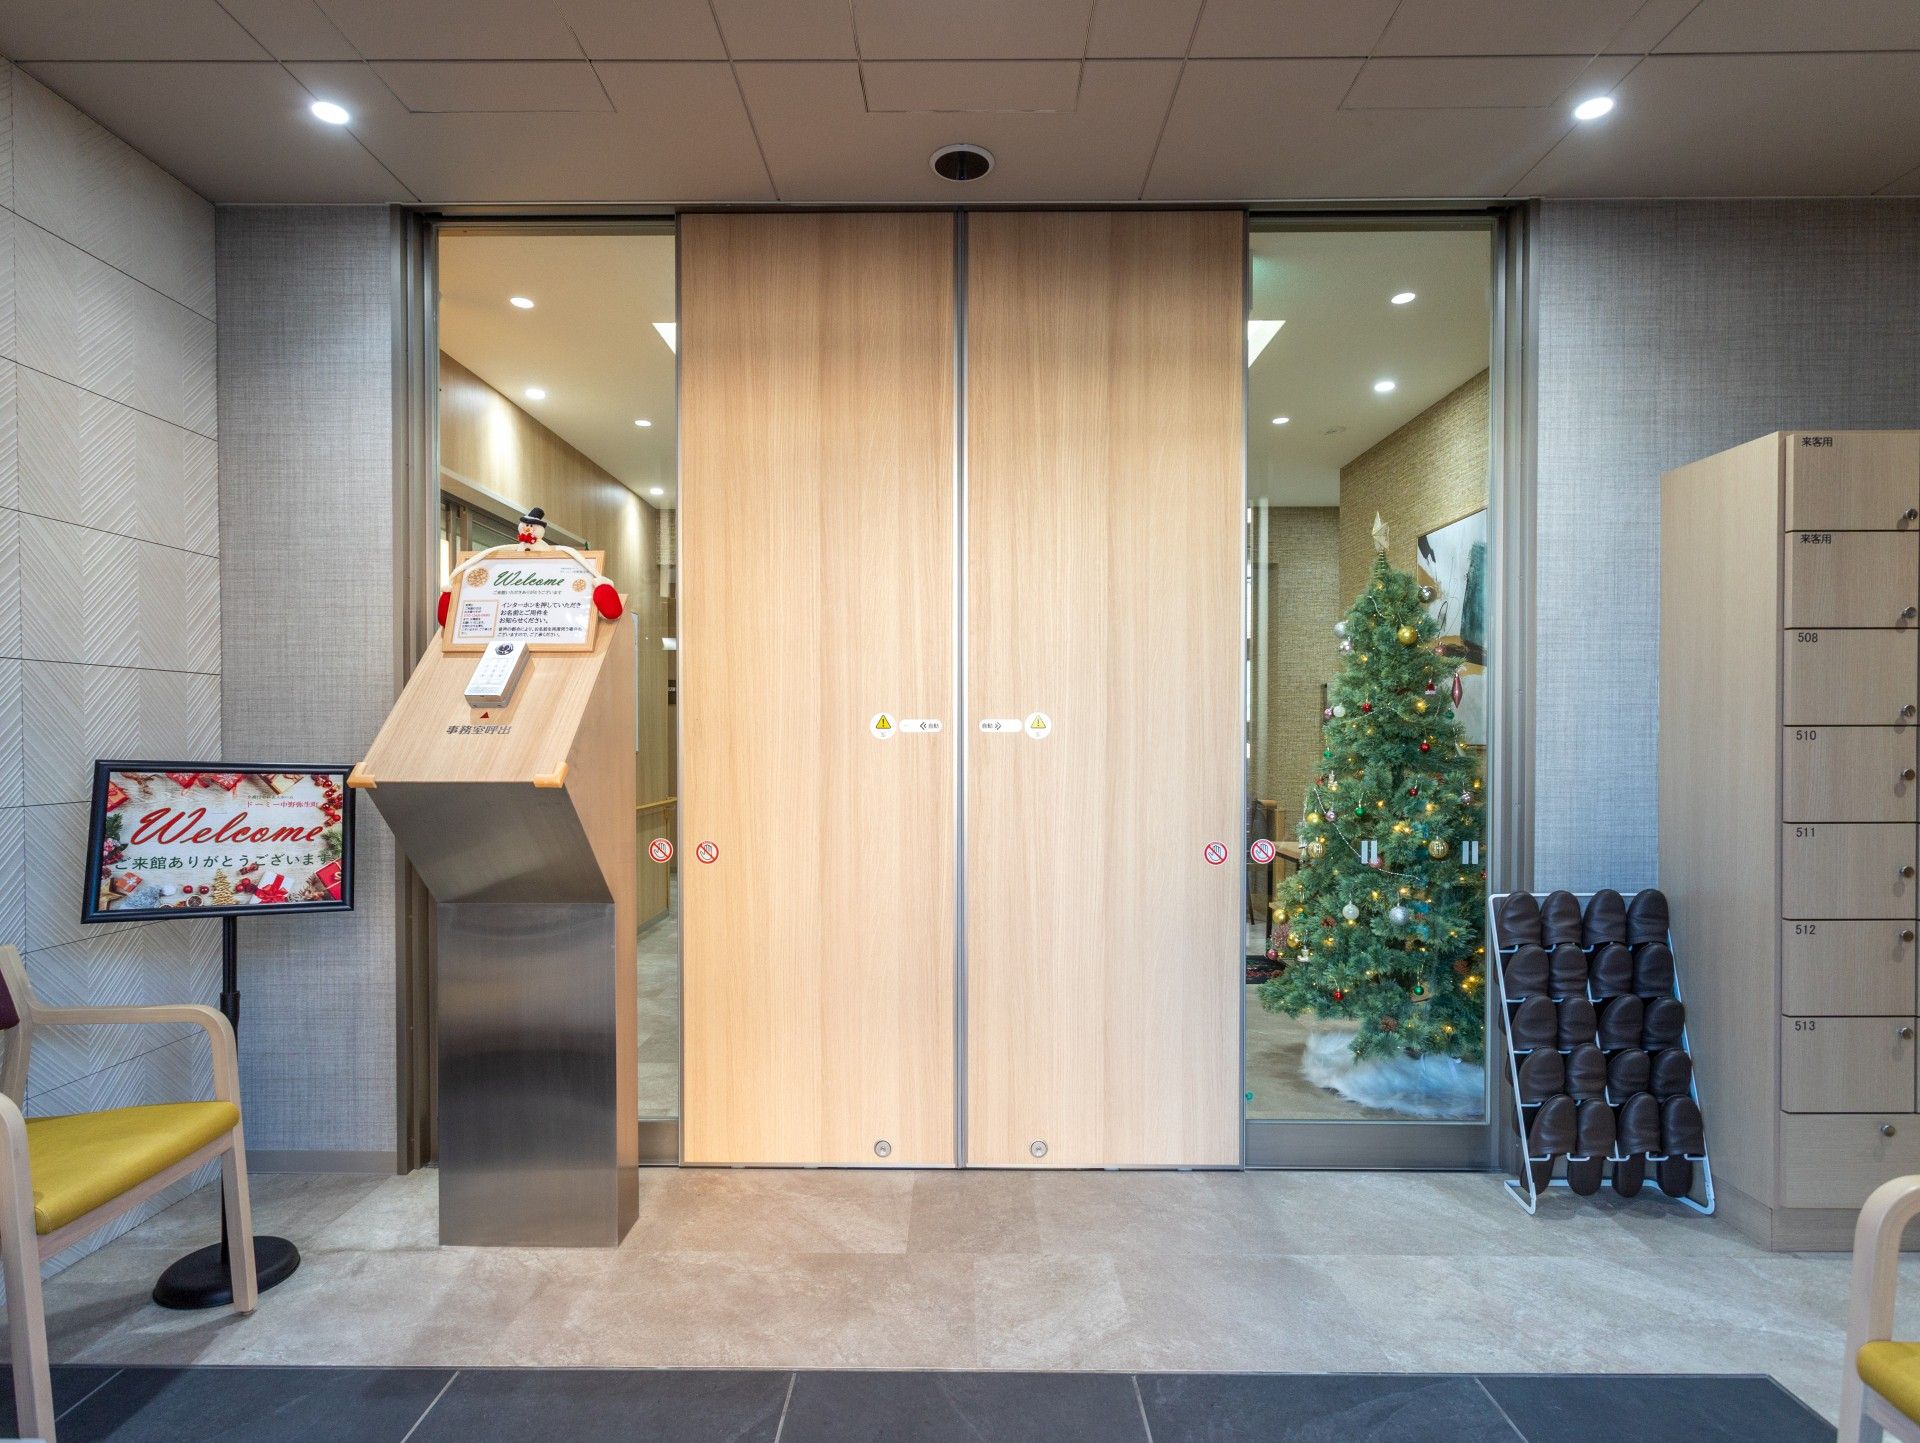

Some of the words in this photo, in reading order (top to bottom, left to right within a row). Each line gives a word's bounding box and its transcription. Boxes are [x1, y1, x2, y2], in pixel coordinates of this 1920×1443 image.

[1801, 436, 1833, 448] 来客用
[1800, 533, 1832, 545] 来客用
[493, 570, 565, 587] Welcome
[1797, 632, 1818, 643] 508
[446, 725, 512, 735] 事務室呼出
[1796, 730, 1817, 741] 510
[130, 807, 325, 845] Welcome
[1795, 827, 1816, 838] 511
[115, 852, 332, 871] ご来館ありがとうございます
[1795, 924, 1816, 935] 512
[1794, 1020, 1816, 1032] 513
